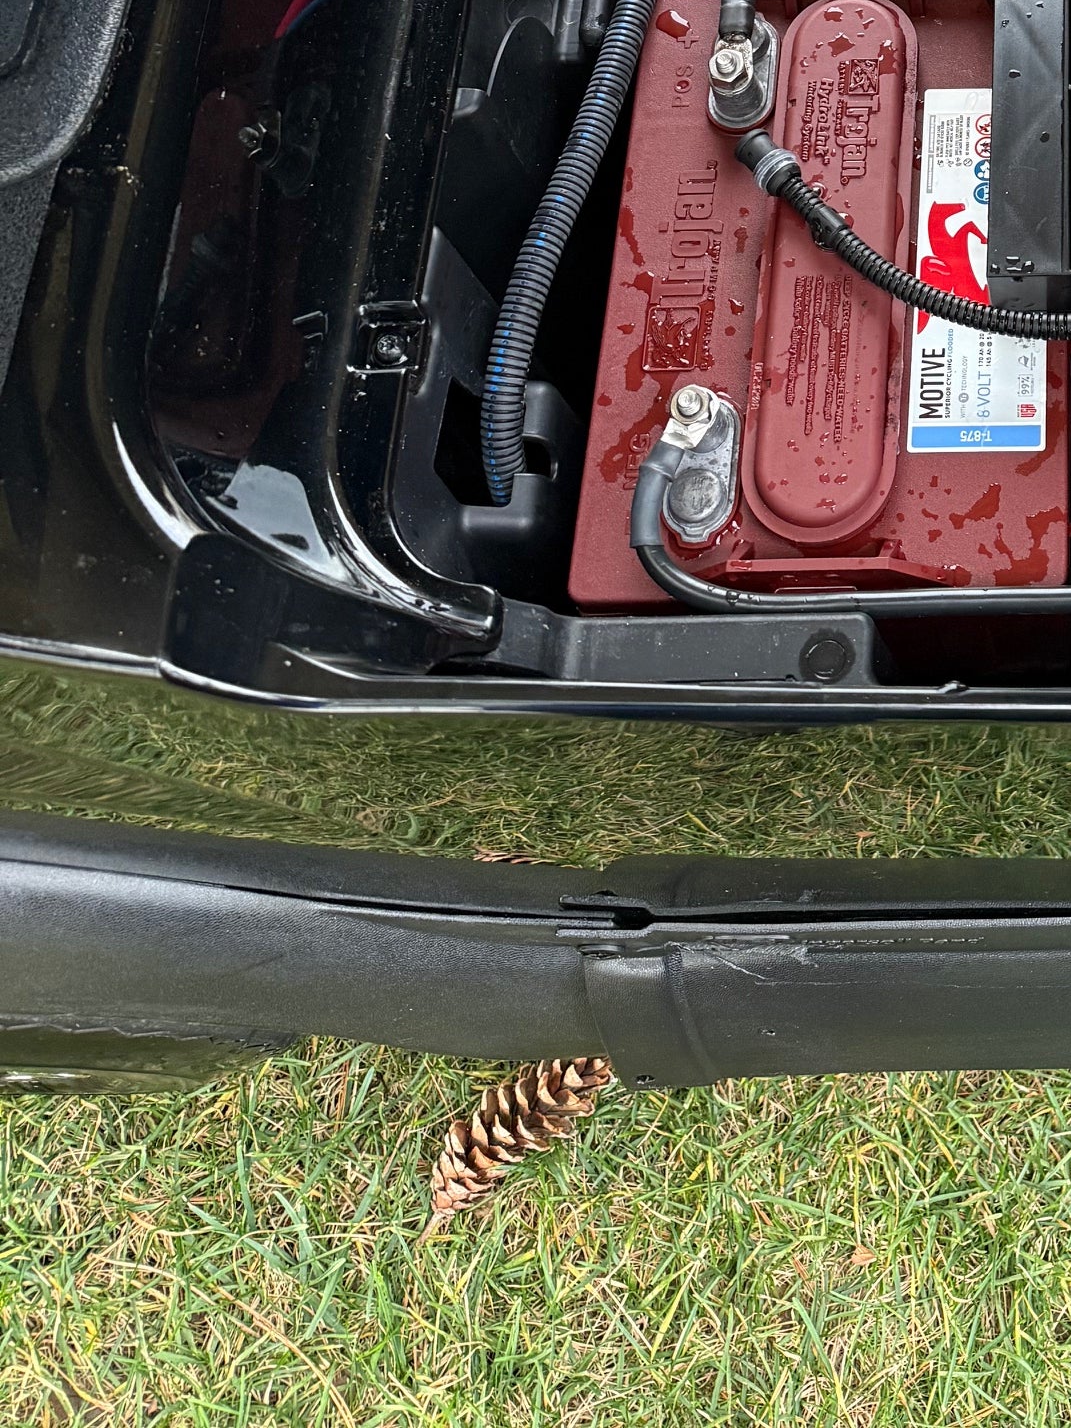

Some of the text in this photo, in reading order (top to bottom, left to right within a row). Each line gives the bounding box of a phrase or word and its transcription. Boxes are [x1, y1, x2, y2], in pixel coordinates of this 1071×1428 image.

[671, 65, 694, 108] POS
[814, 77, 834, 159] HydroLink
[835, 95, 880, 178] Trojan
[651, 170, 723, 305] Trojan
[919, 348, 945, 419] MOTIVE
[977, 371, 991, 407] VOLT
[1021, 376, 1030, 395] 99%
[1020, 404, 1037, 417] USA
[622, 432, 651, 490] NEG
[960, 430, 992, 442] T-875
